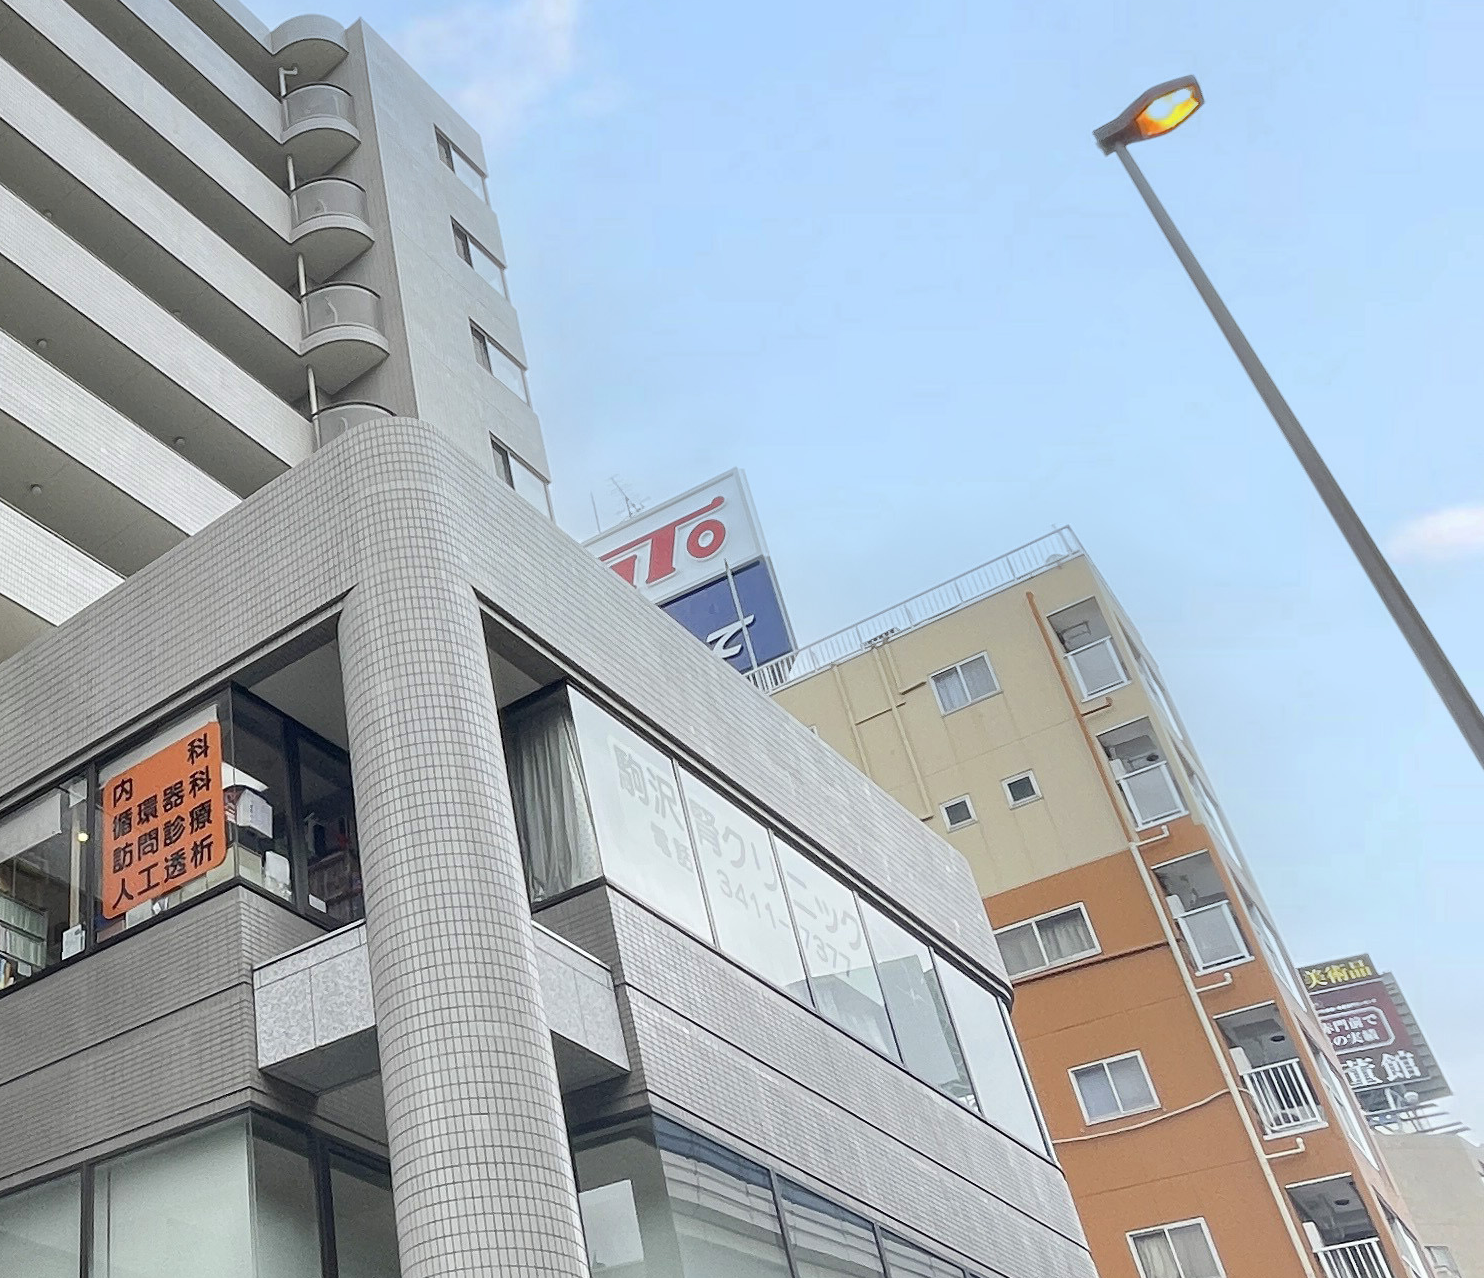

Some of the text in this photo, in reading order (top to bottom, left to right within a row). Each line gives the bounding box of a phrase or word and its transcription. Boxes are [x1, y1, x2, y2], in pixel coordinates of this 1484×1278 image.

[112, 765, 212, 841] 循環器科
[112, 799, 213, 874] 訪問診療
[112, 833, 215, 911] 人工透析
[1303, 959, 1373, 989] 美術品
